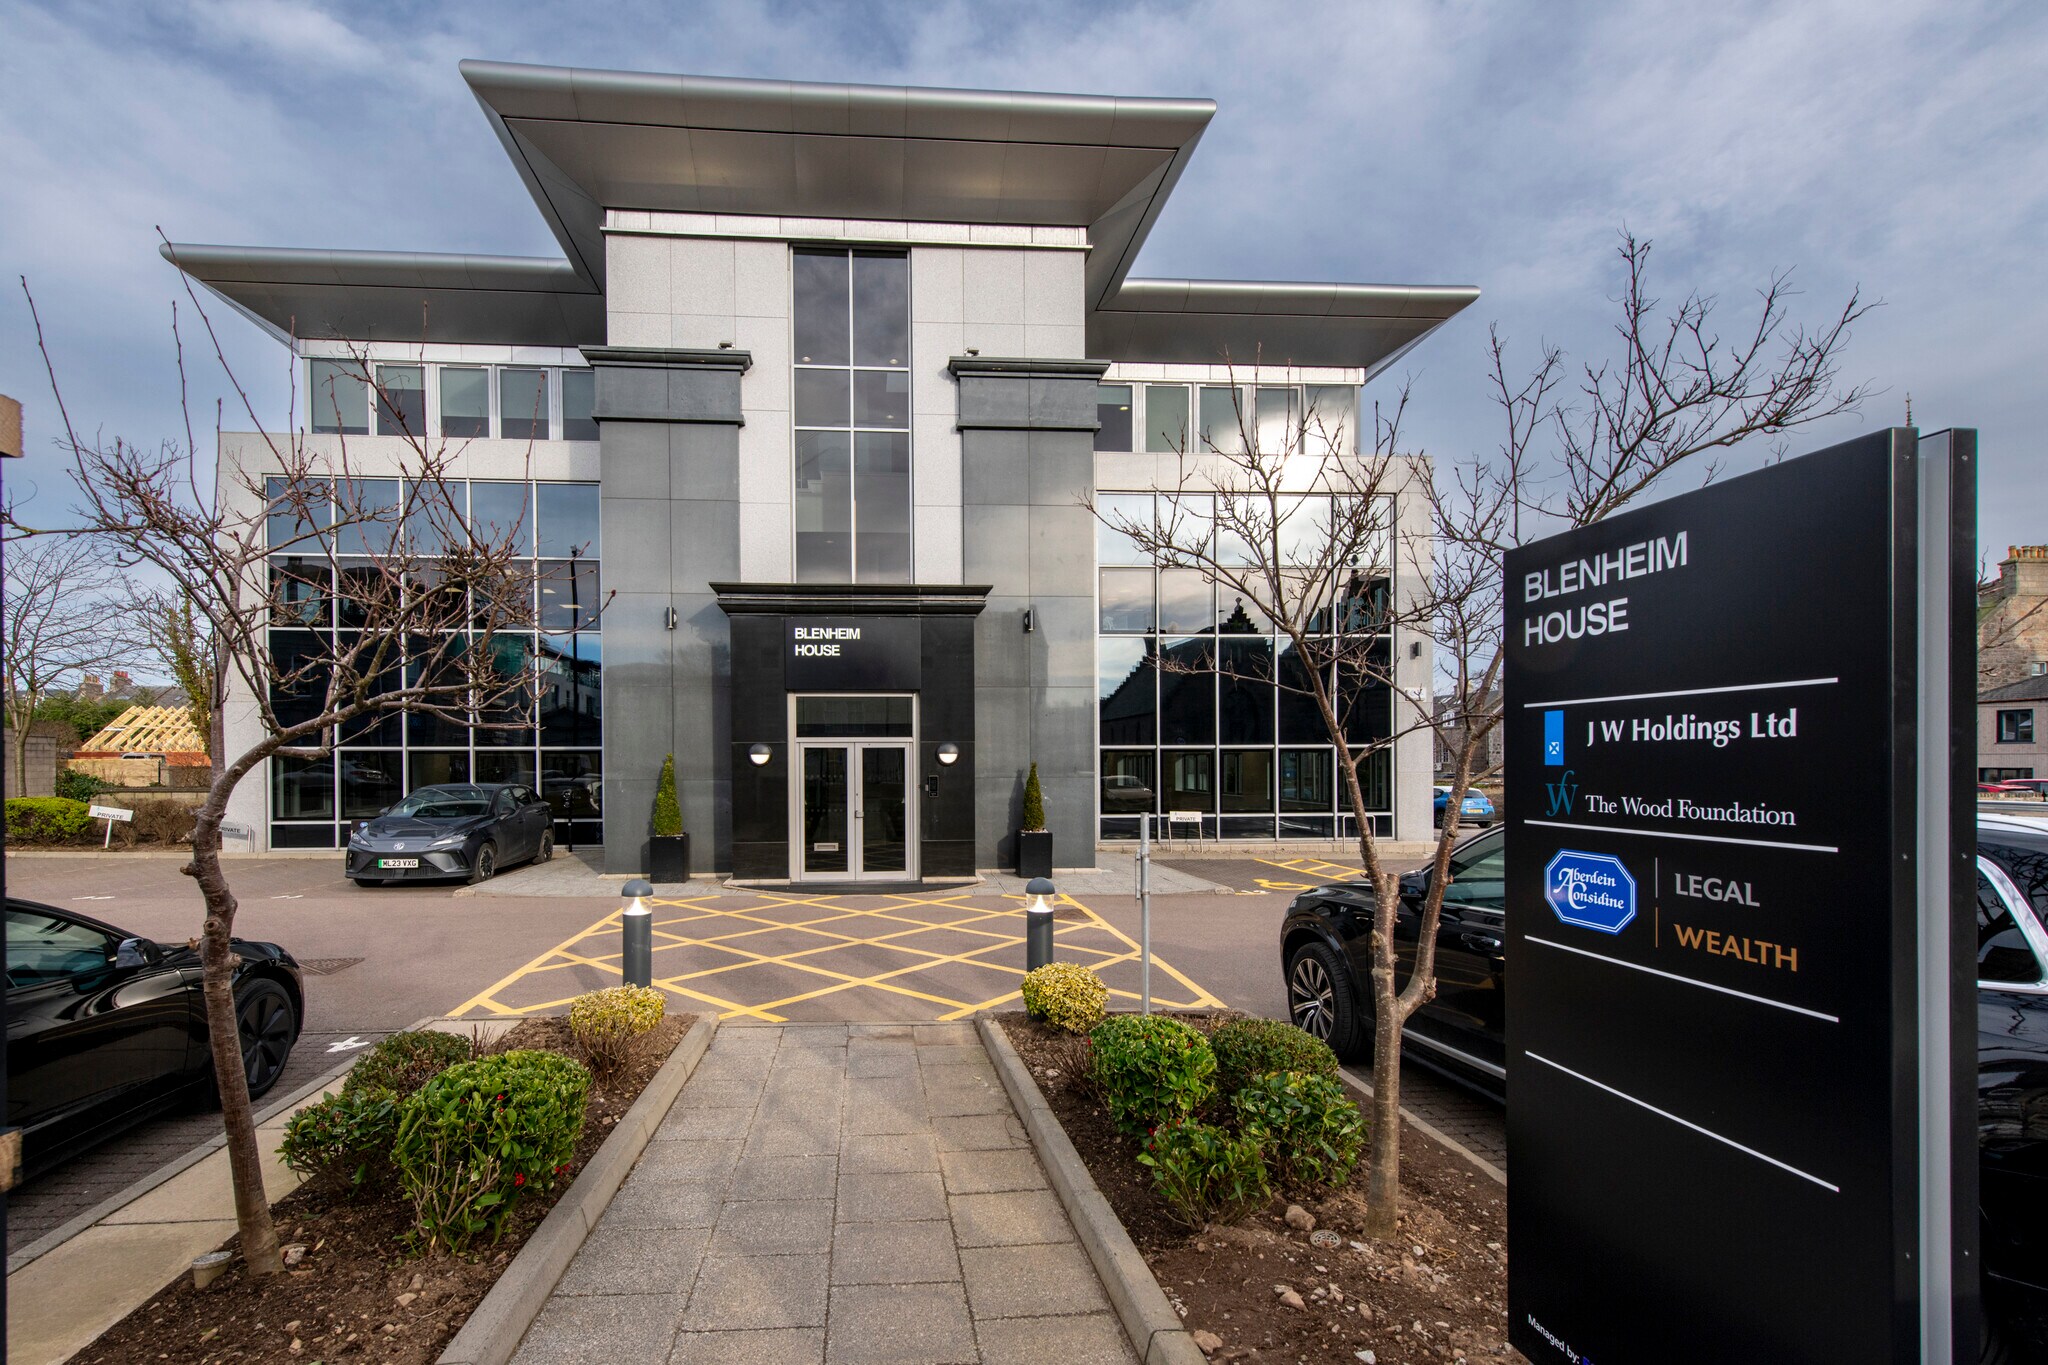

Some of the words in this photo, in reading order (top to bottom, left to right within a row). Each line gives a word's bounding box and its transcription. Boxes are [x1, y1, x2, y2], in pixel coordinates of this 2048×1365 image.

[1525, 530, 1688, 603] BLENHEIM
[795, 628, 861, 640] BLENHEIM
[1525, 597, 1629, 647] HOUSE
[795, 644, 841, 657] HOUSE
[1587, 721, 1594, 747] J
[1600, 719, 1625, 742] W
[1632, 713, 1741, 748] Holdings
[1751, 708, 1797, 738] Ltd
[97, 811, 125, 820] PRIVATE
[1585, 794, 1618, 815] The
[1621, 796, 1673, 818] Wood
[1677, 799, 1797, 826] Foundation
[1553, 867, 1617, 894] Aberdein
[1567, 881, 1625, 910] Considine
[1674, 873, 1760, 907] LEGAL
[1673, 923, 1798, 972] WEALTH
[1528, 1313, 1565, 1352] Managed
[1566, 1344, 1580, 1365] by:
